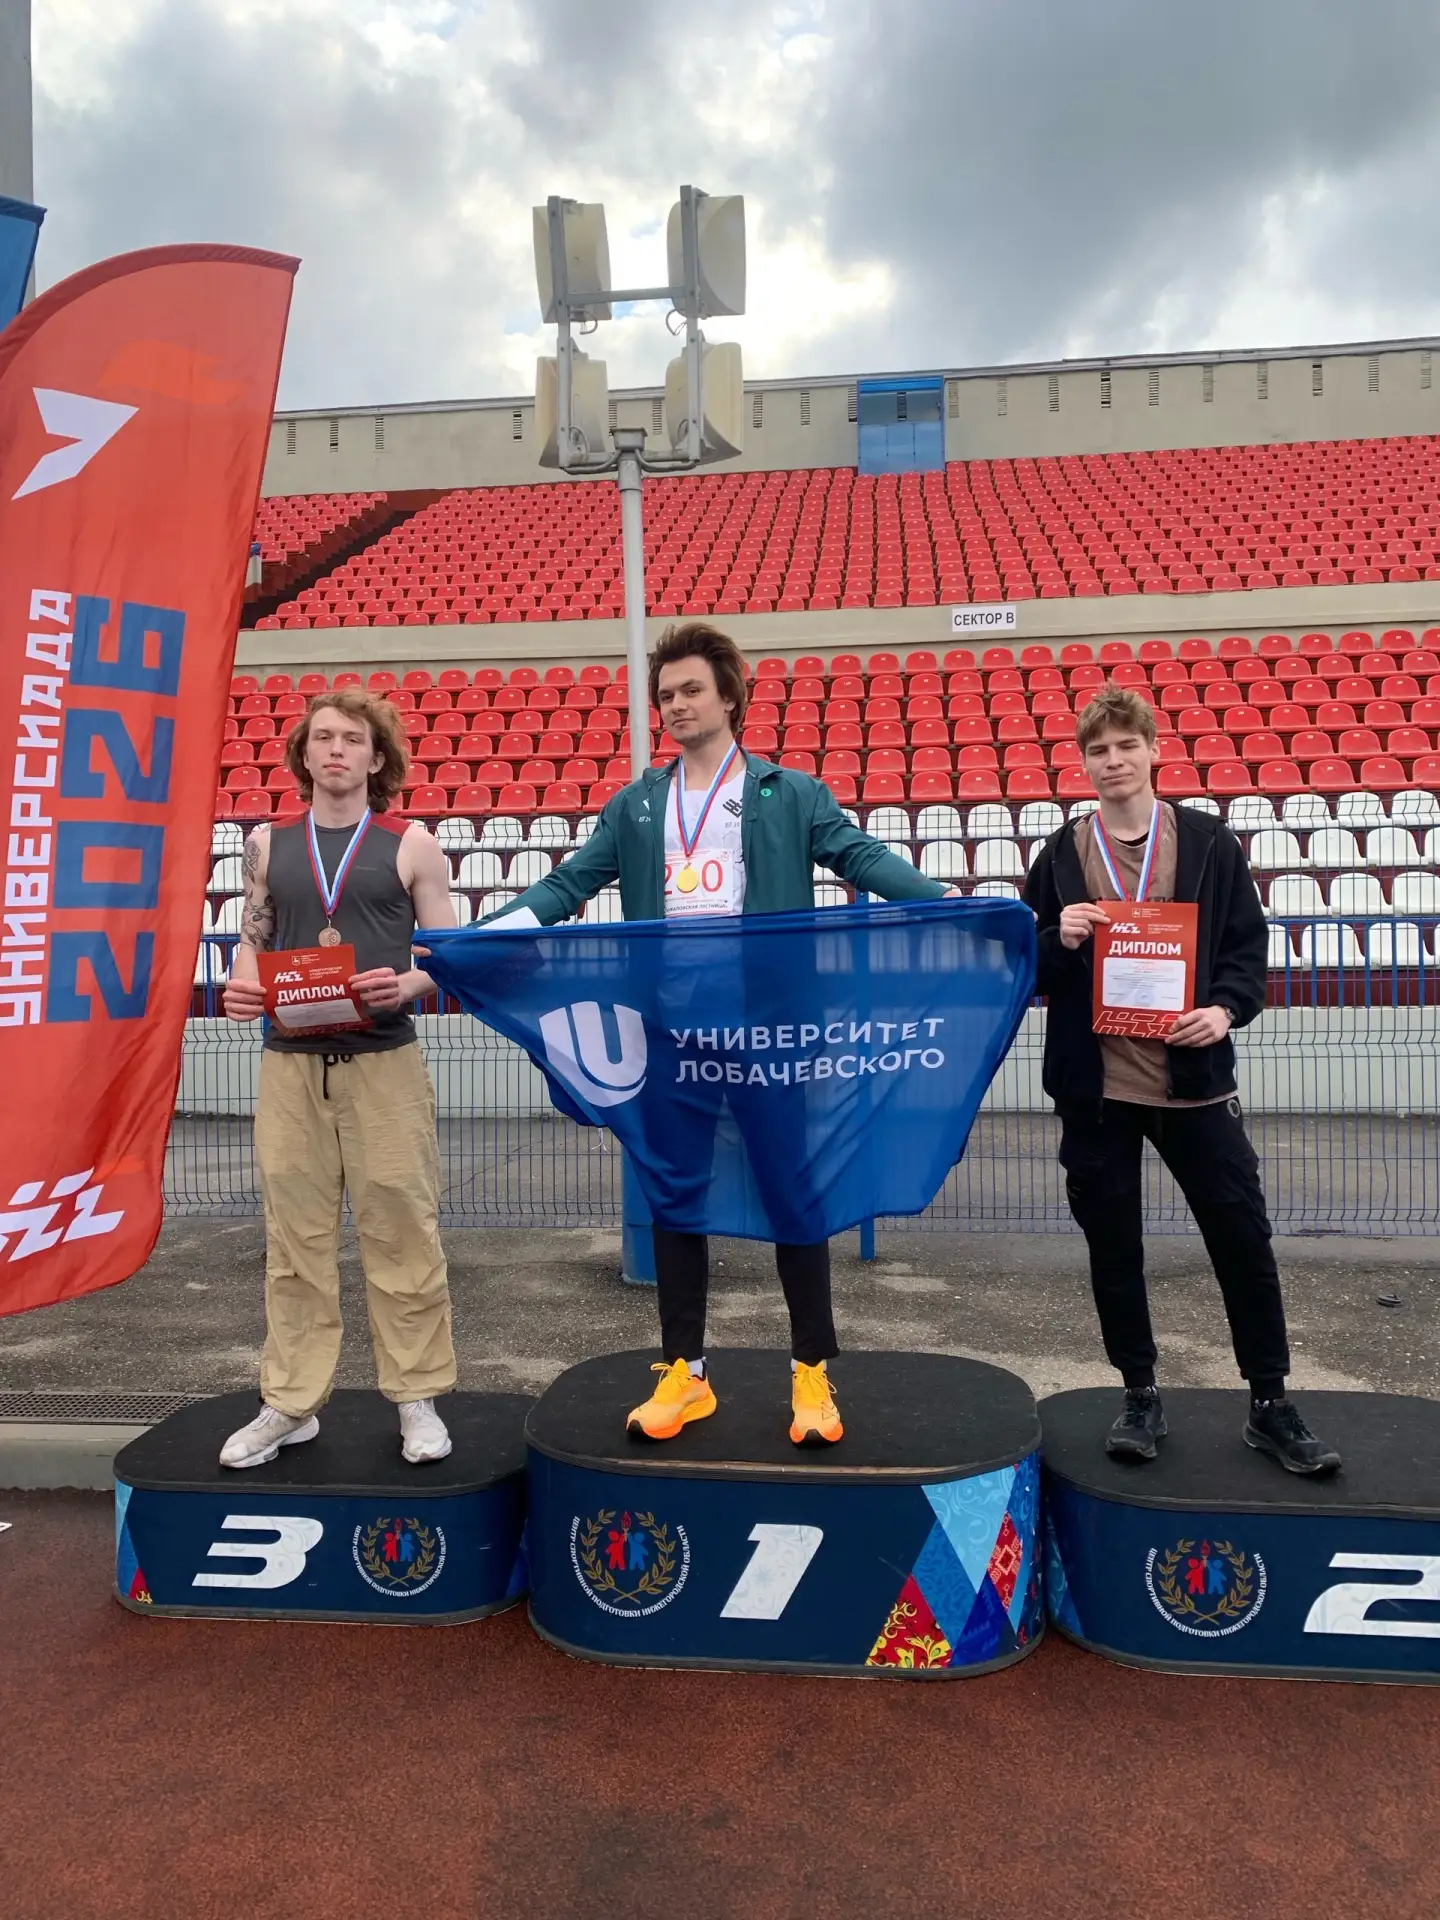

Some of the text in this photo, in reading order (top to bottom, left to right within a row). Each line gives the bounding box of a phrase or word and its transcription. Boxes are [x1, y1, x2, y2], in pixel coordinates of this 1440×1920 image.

[954, 613, 1003, 626] СЕКТОР
[0, 588, 73, 1027] УНИВЕРСИАДА
[45, 594, 187, 1023] 2026
[1109, 940, 1182, 956] ДИПЛОМ
[276, 984, 345, 1005] ДИПЛОМ
[670, 1017, 945, 1050] УНИВЕРСИТЕТ
[675, 1048, 945, 1086] ЛОБАЧЕВСКОГО
[192, 1515, 324, 1588] 3
[591, 1594, 641, 1618] ПОДГОТОВКИ
[642, 1565, 690, 1616] НИЖЕГОРОДСКОЙ
[676, 1524, 691, 1564] ОБЛАСТИ
[719, 1523, 824, 1620] 1
[1170, 1617, 1220, 1638] ПОДГОТОВКИ
[1220, 1590, 1267, 1637] НИЖЕГОРОДСКОЙ
[1253, 1552, 1267, 1588] ОБЛАСТИ
[1303, 1552, 1440, 1639] 2
